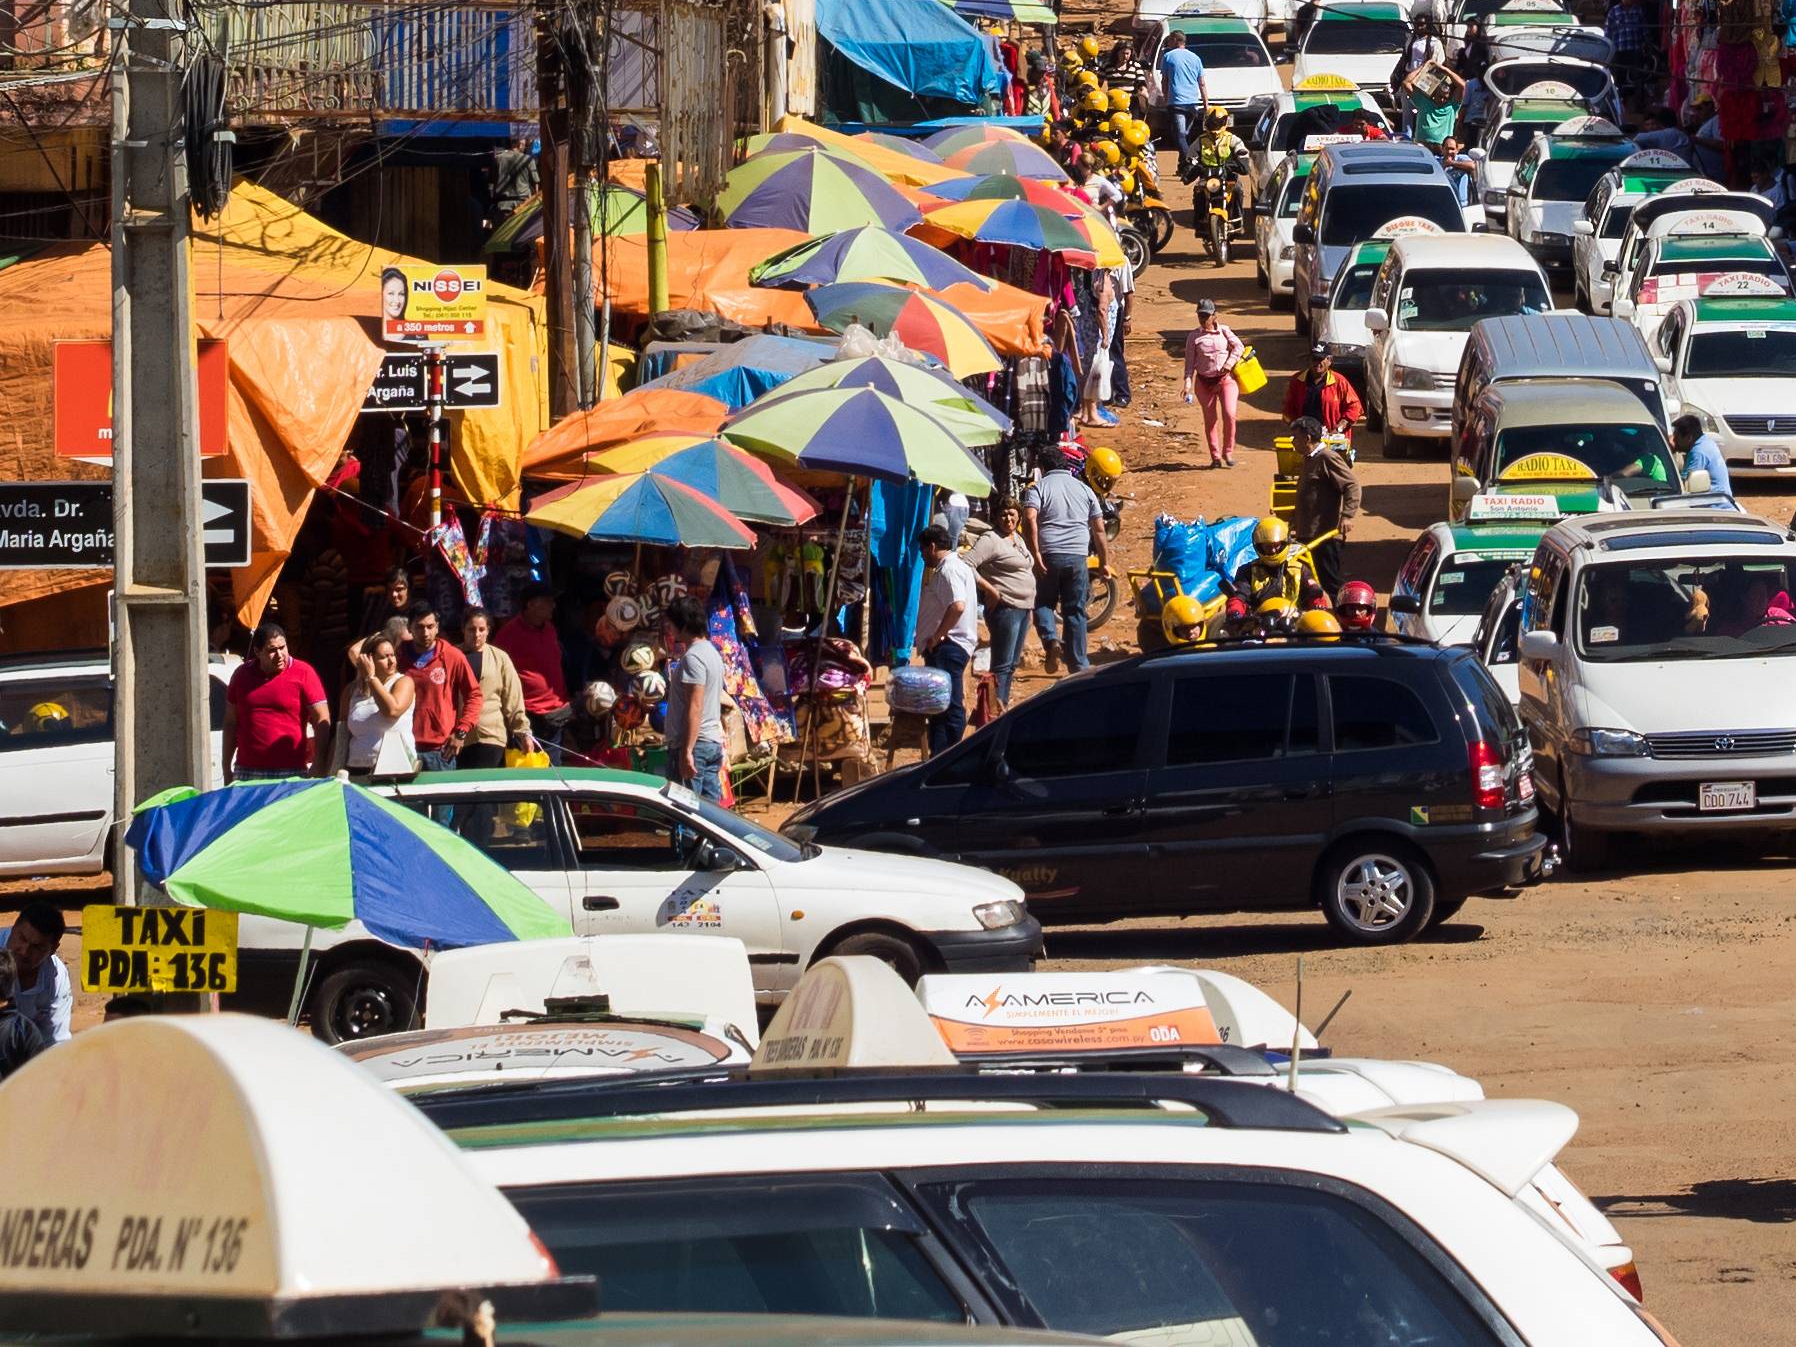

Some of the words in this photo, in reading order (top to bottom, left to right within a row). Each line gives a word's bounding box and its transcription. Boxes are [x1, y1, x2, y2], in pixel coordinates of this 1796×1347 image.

[1702, 221, 1715, 229] 14
[413, 279, 481, 292] NISSEI
[1737, 281, 1749, 289] 22
[404, 323, 422, 332] 350
[424, 323, 455, 332] metros
[389, 364, 418, 378] Luis
[1517, 456, 1550, 472] RADIO
[1552, 457, 1578, 471] TAXI
[55, 498, 84, 517] Dr.
[1483, 497, 1508, 506] TAXI
[1510, 498, 1545, 506] RADIO
[1728, 792, 1750, 807] 744
[114, 908, 206, 946] TAXI
[997, 1032, 1145, 1046] www.casawireless.com.py
[1011, 1028, 1053, 1038] Shopping
[1150, 1026, 1181, 1042] ODA
[111, 1217, 166, 1272] PDA.
[202, 1218, 249, 1274] 136
